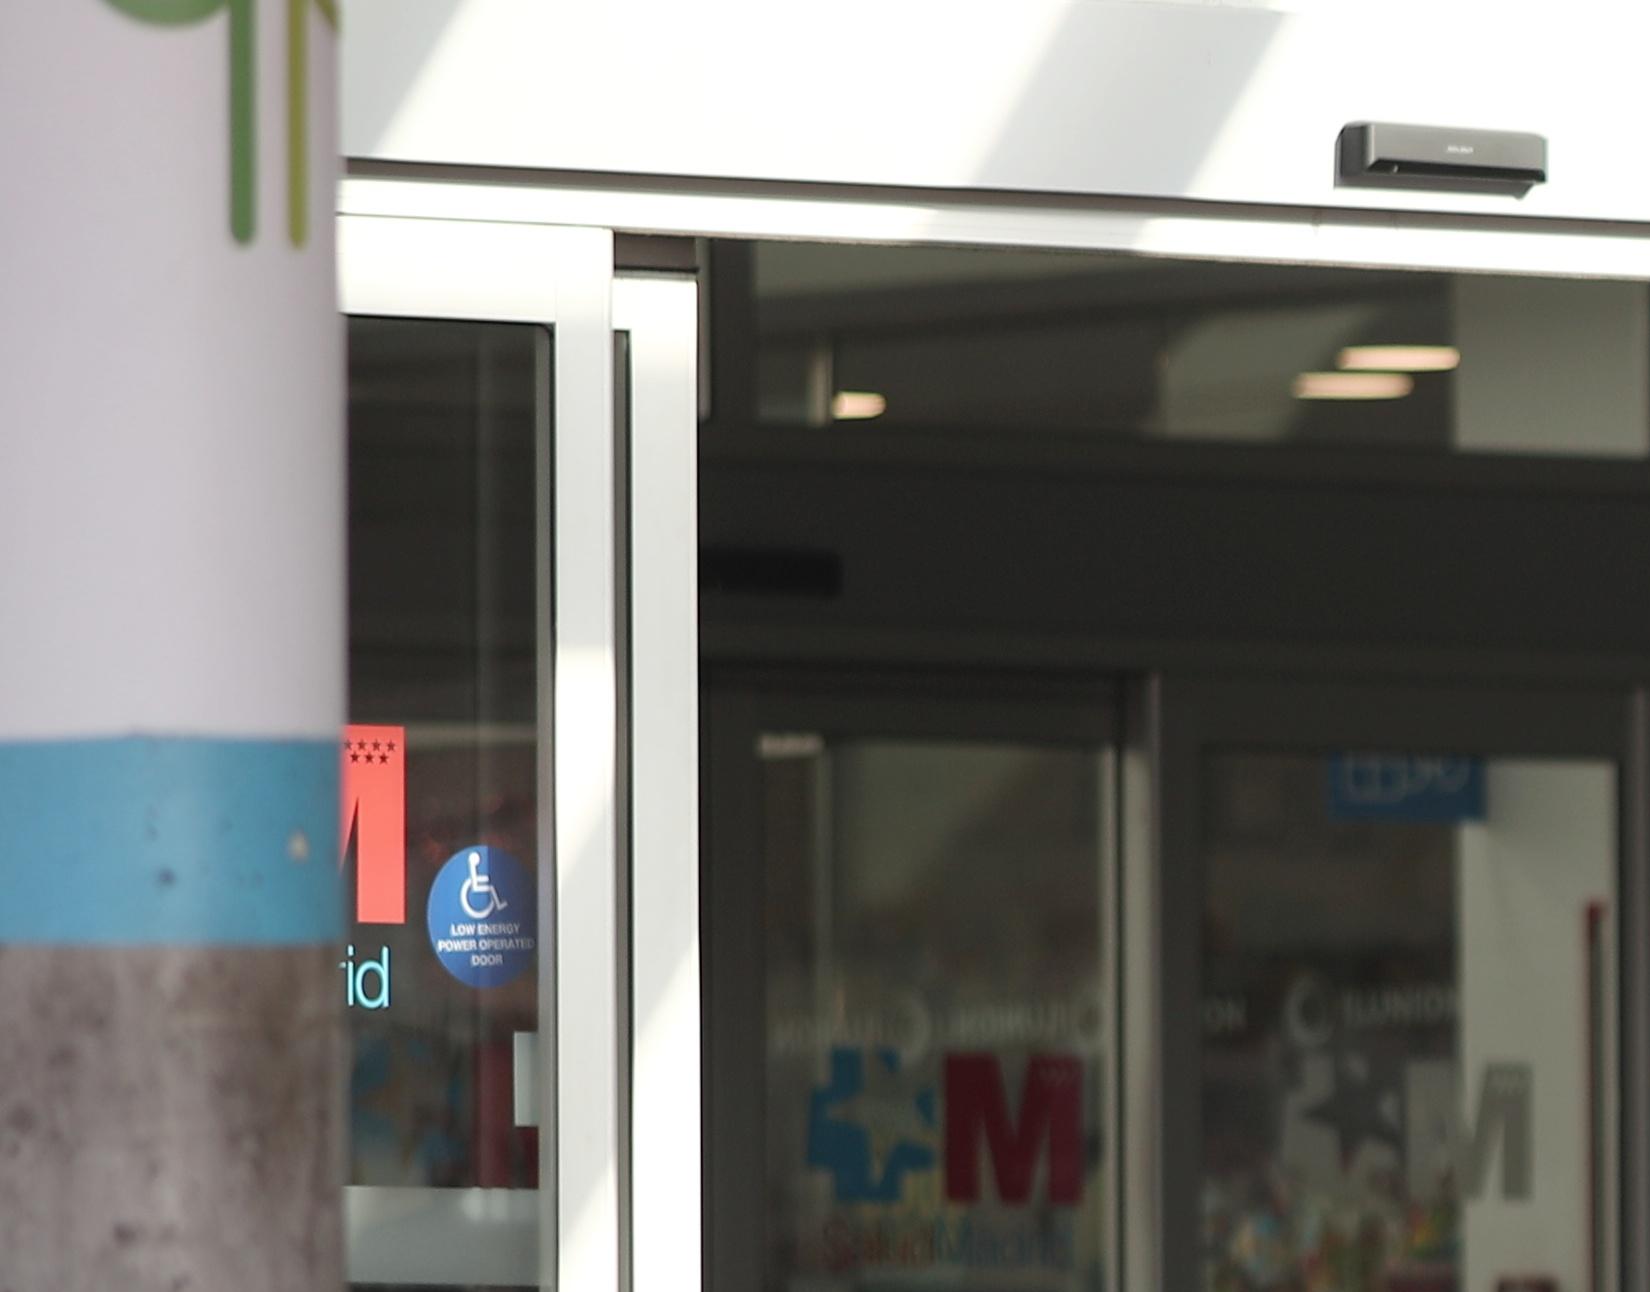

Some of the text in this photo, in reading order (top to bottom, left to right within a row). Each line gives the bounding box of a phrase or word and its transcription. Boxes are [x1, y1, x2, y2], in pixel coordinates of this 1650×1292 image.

[450, 922, 520, 936] LOW ENERGY
[437, 938, 536, 952] POWER OPERATED
[470, 954, 504, 967] DOOR
